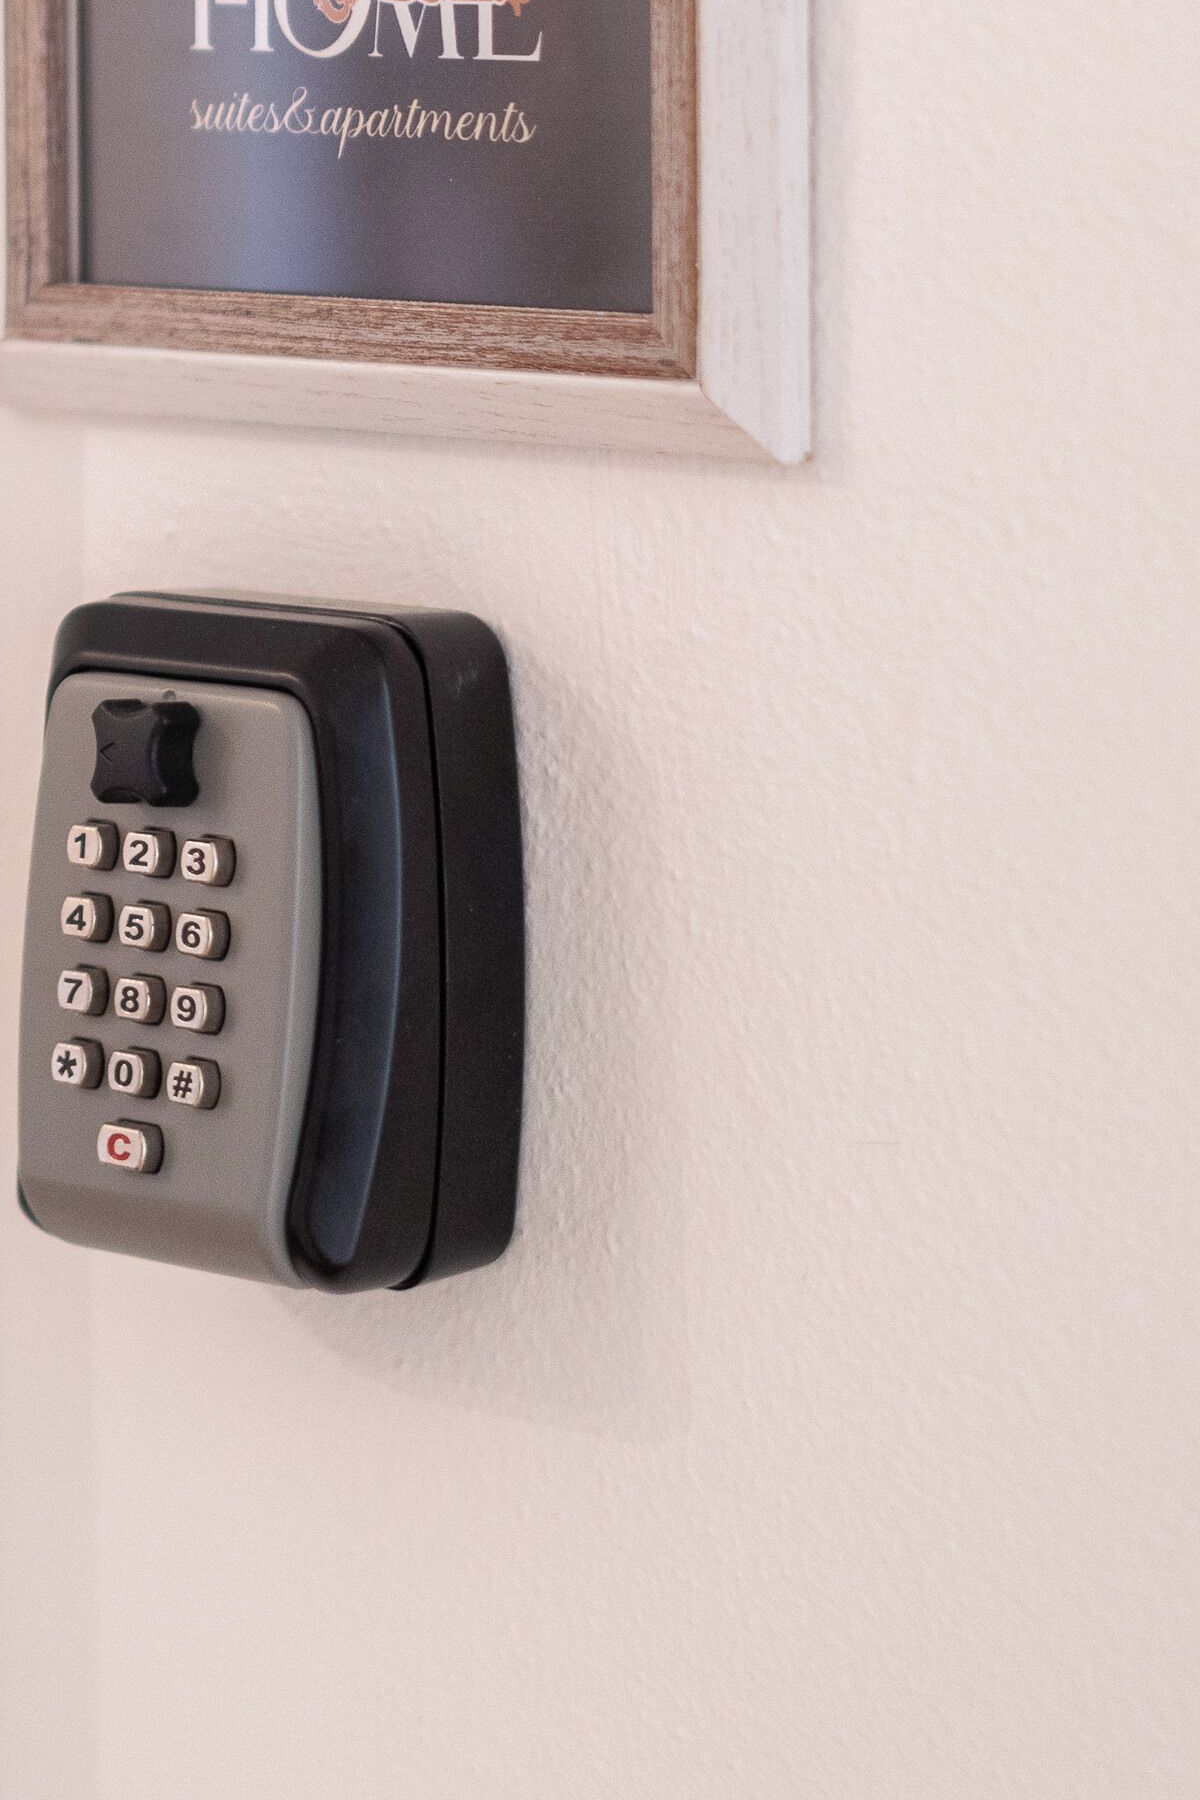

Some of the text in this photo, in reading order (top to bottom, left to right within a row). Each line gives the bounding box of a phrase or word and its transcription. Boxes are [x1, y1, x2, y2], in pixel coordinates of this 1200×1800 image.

[74, 833, 206, 875] 1 2 3
[66, 905, 201, 949] 4 5 6
[63, 978, 197, 1022] 7 8 9
[114, 1060, 133, 1087] 0
[173, 1069, 193, 1098] #
[106, 1133, 131, 1162] C
